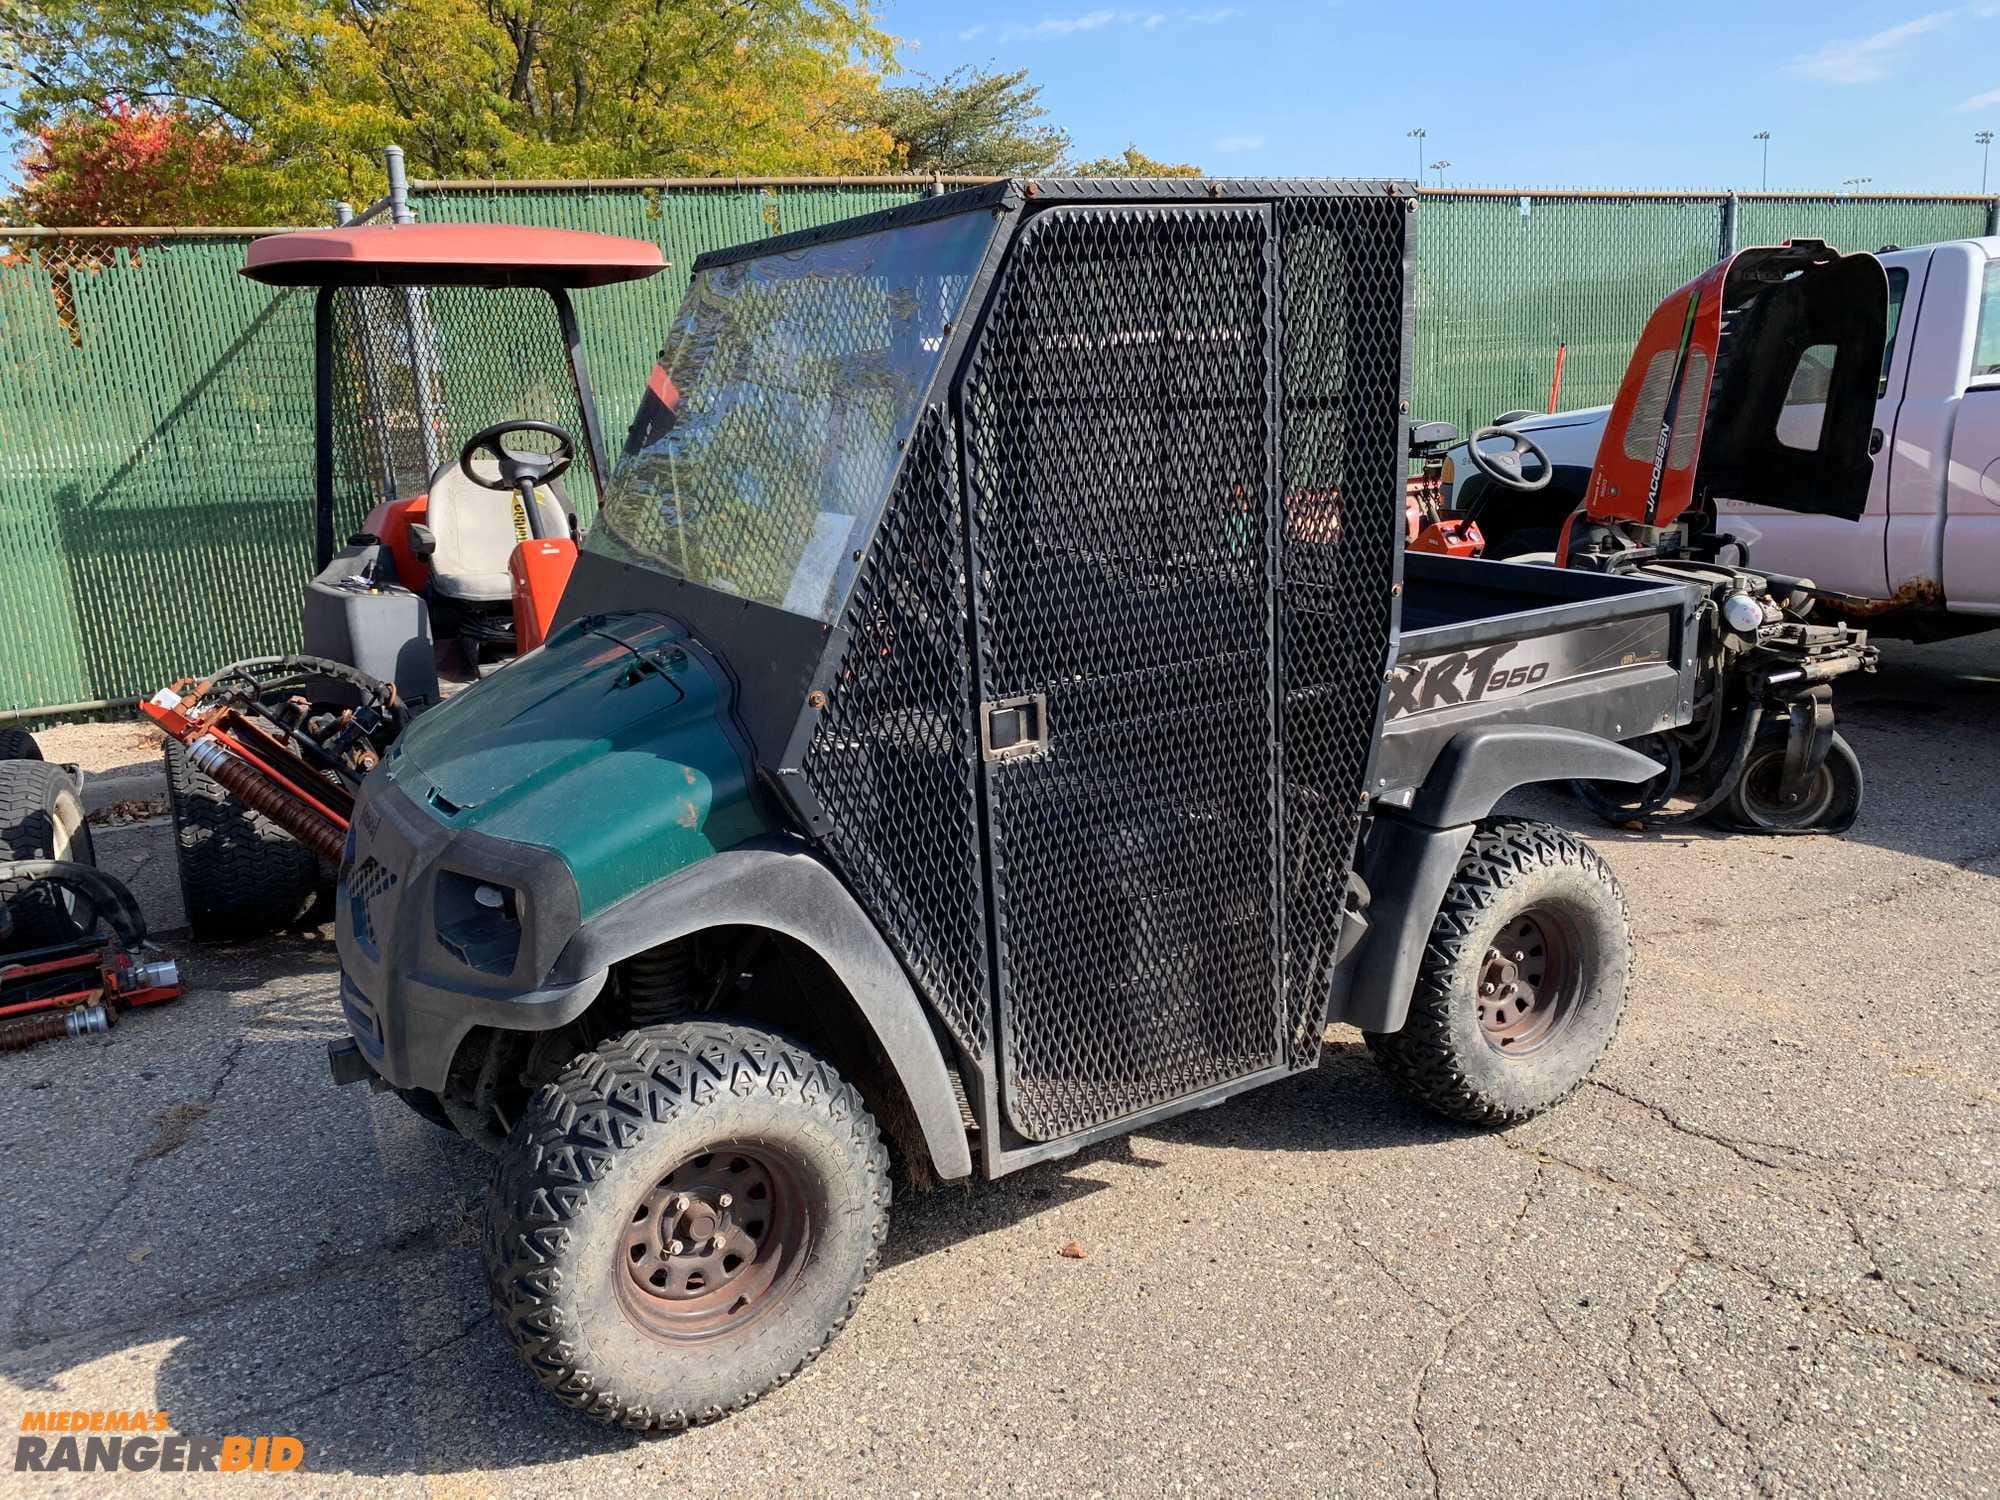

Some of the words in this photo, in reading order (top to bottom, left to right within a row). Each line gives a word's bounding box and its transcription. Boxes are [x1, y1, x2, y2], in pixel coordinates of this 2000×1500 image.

[1646, 422, 1670, 513] JACOBSEN
[1386, 641, 1518, 721] XRT
[1486, 662, 1550, 692] 950
